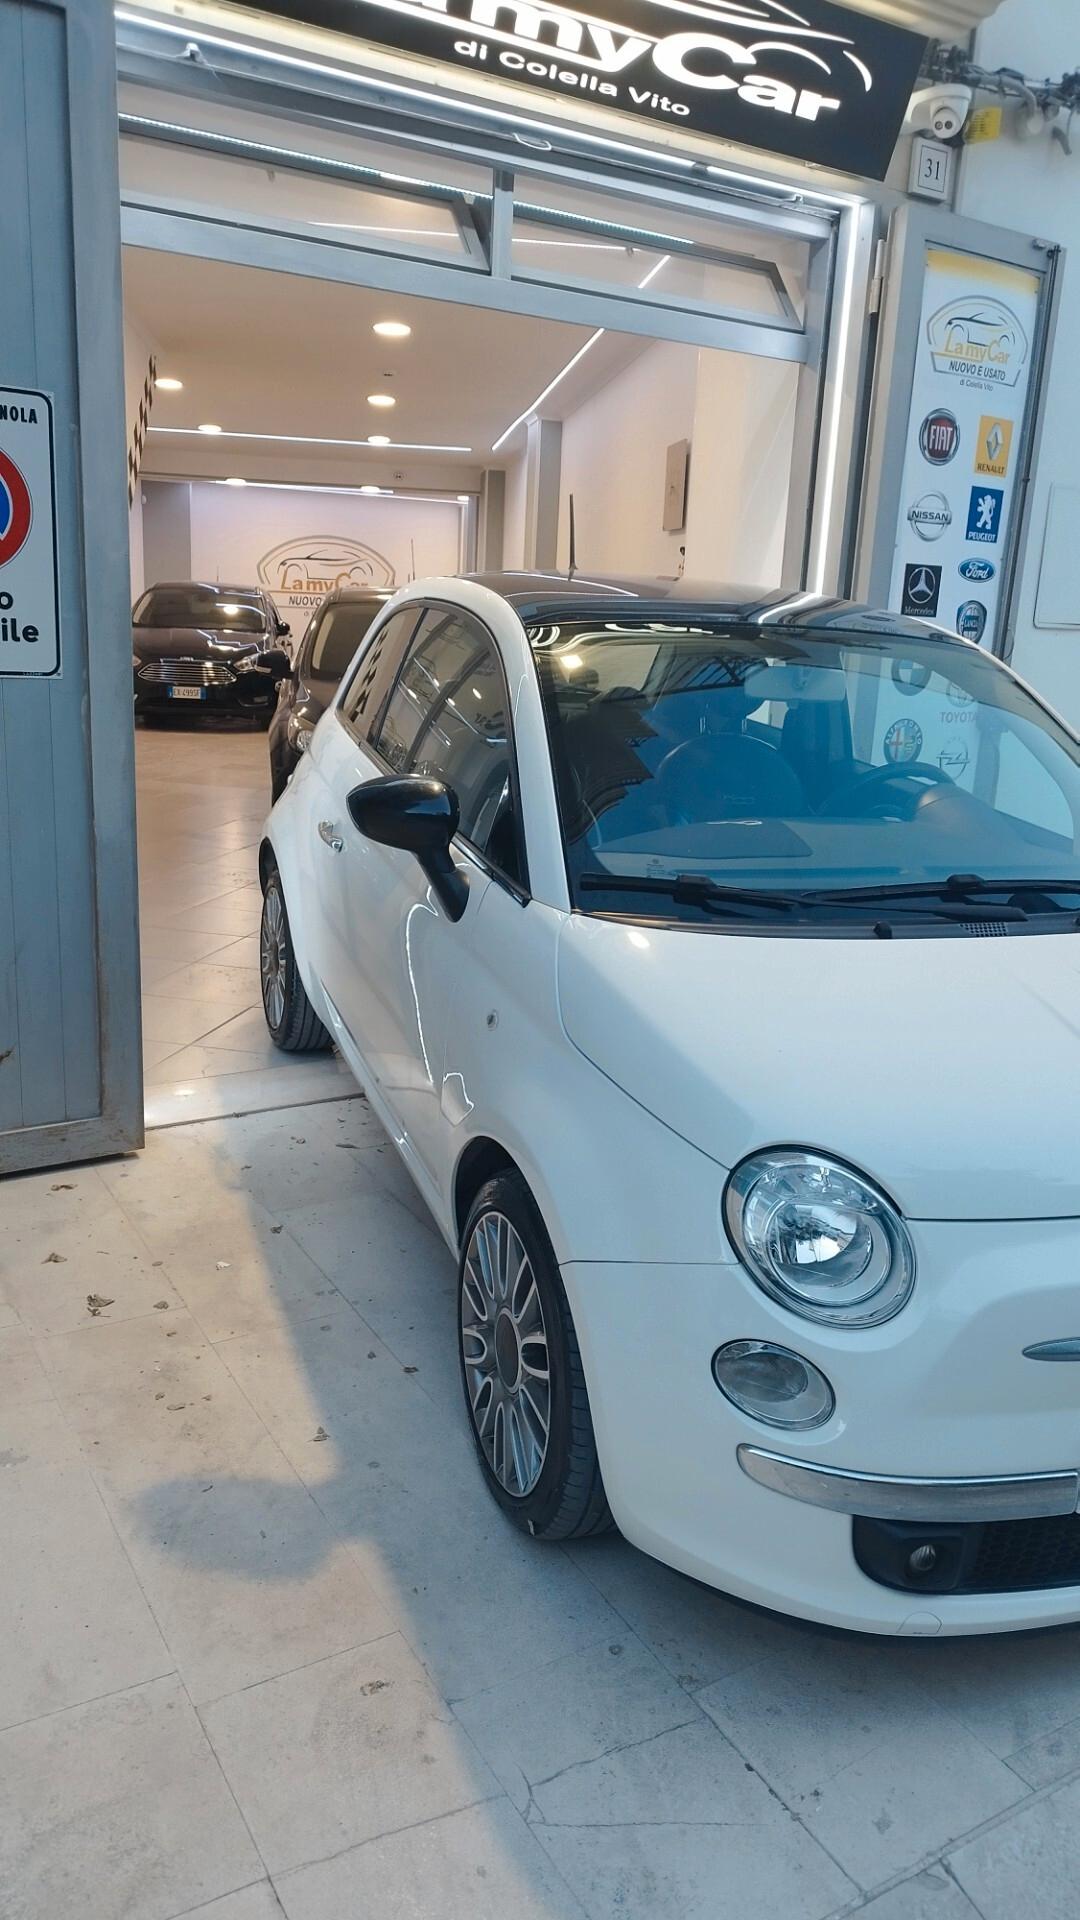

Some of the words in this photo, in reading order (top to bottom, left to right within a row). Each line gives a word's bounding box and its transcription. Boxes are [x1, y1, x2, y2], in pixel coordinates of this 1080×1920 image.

[454, 41, 488, 60] di
[499, 51, 618, 97] Colella
[628, 86, 691, 116] Vito
[924, 158, 941, 181] 31
[948, 360, 977, 375] NUOVO
[977, 365, 984, 376] E
[983, 367, 1006, 381] USATO
[928, 424, 953, 451] FIAT
[976, 463, 1005, 475] RENAULT
[911, 509, 949, 522] NISSAN
[968, 531, 996, 542] PEUGEOT
[965, 561, 990, 579] Ford
[904, 605, 935, 615] Mercedes
